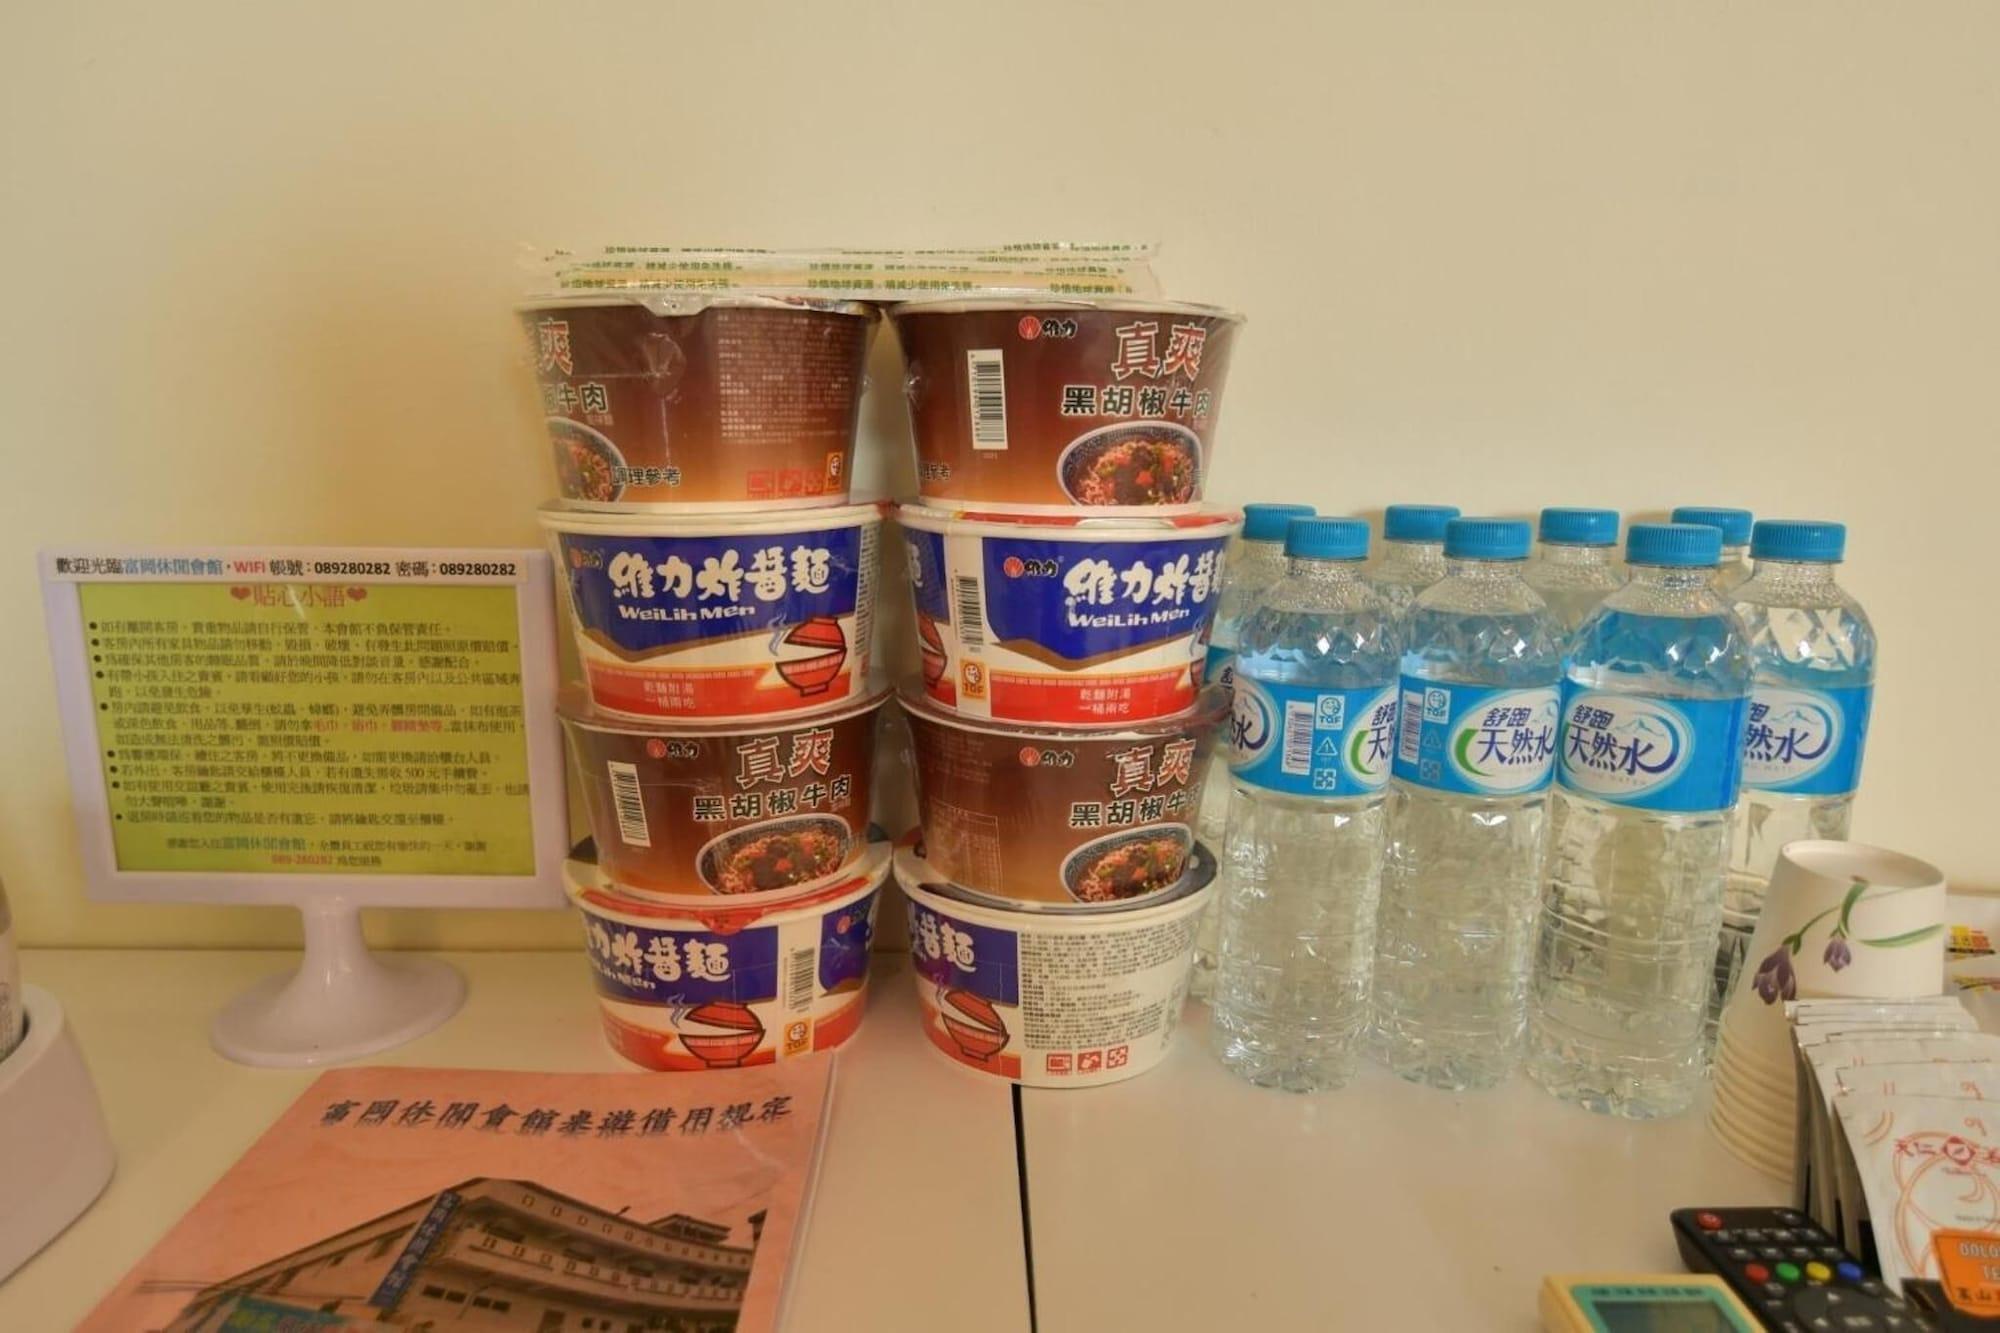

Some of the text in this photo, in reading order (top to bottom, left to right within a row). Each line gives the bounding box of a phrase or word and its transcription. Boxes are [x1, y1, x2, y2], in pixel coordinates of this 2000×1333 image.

[1111, 322, 1207, 381] 真爽
[618, 604, 756, 621] WeiLih Men
[1068, 608, 1190, 628] WeiLih Men
[1482, 707, 1532, 727] 舒跑
[1573, 703, 1616, 731] 舒跑
[736, 727, 834, 789] 真爽
[1476, 725, 1558, 766] 天然水
[1567, 723, 1663, 776] 天然水
[1109, 738, 1196, 798] 真爽
[693, 774, 852, 821] 黑胡椒牛肉
